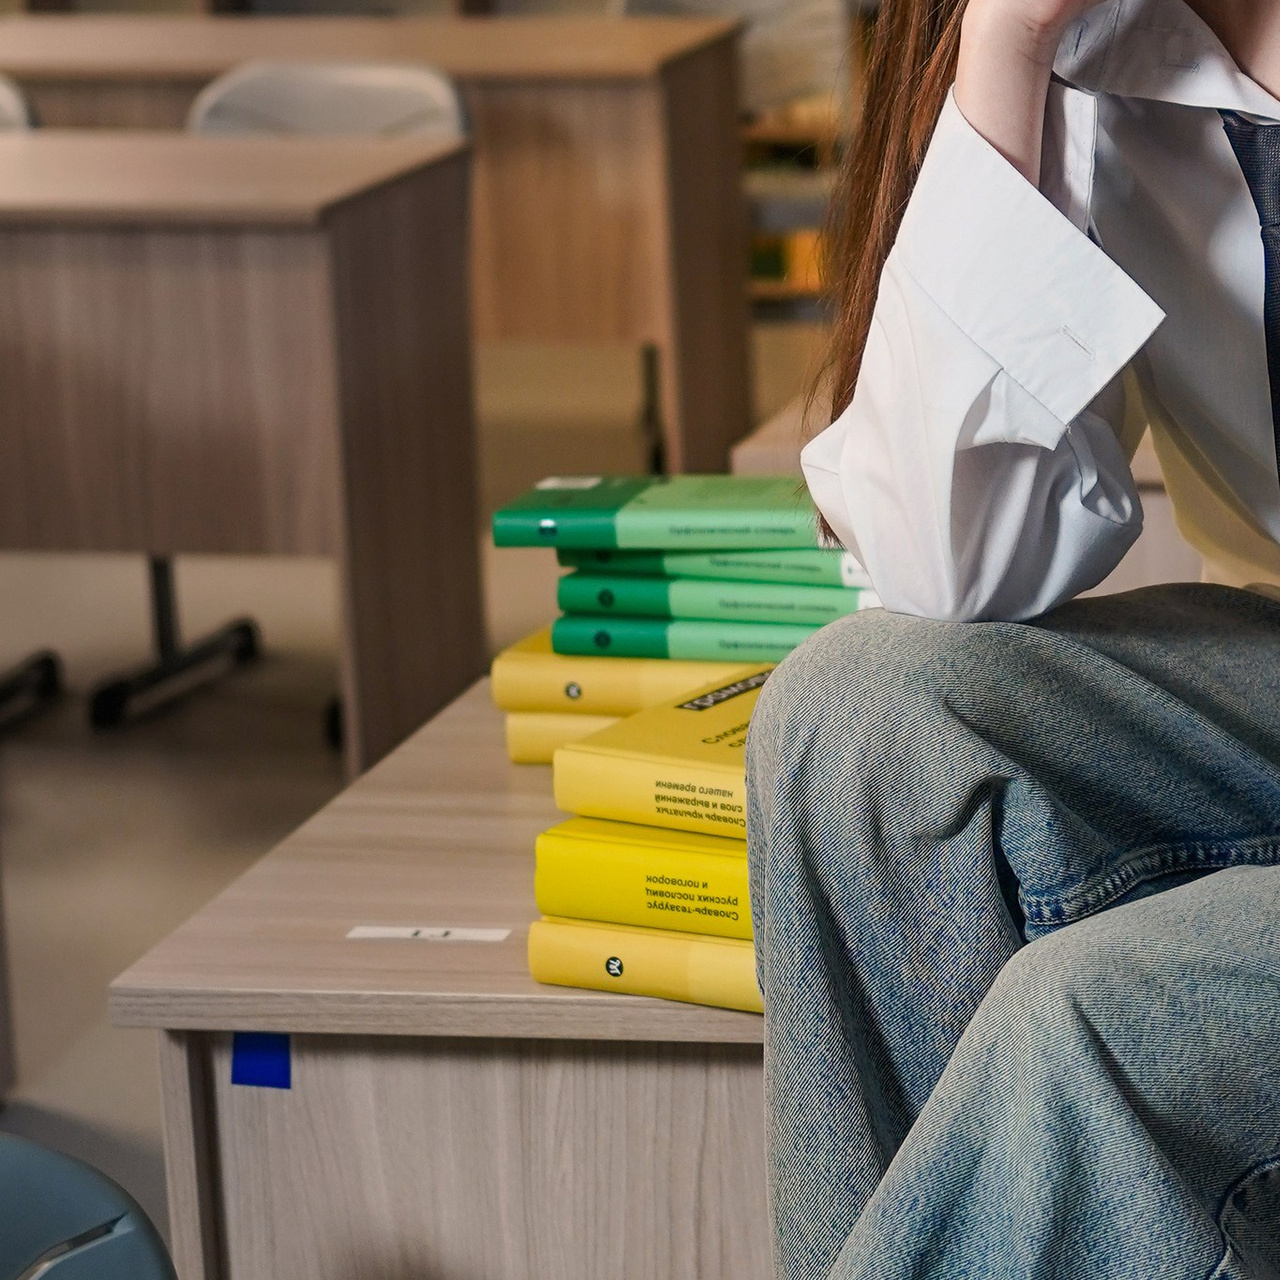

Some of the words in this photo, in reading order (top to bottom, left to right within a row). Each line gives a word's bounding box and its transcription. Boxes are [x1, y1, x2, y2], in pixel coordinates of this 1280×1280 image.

[655, 780, 697, 792] времени
[698, 787, 733, 798] нашего
[655, 794, 710, 808] выражений
[656, 806, 703, 819] крылатых
[720, 804, 743, 813] слов
[705, 813, 746, 827] Словарь
[646, 875, 700, 888] поговорок
[702, 881, 708, 889] и
[645, 887, 695, 901] пословиц
[697, 895, 738, 906] русских
[647, 901, 739, 921] Словарь-тезаурус
